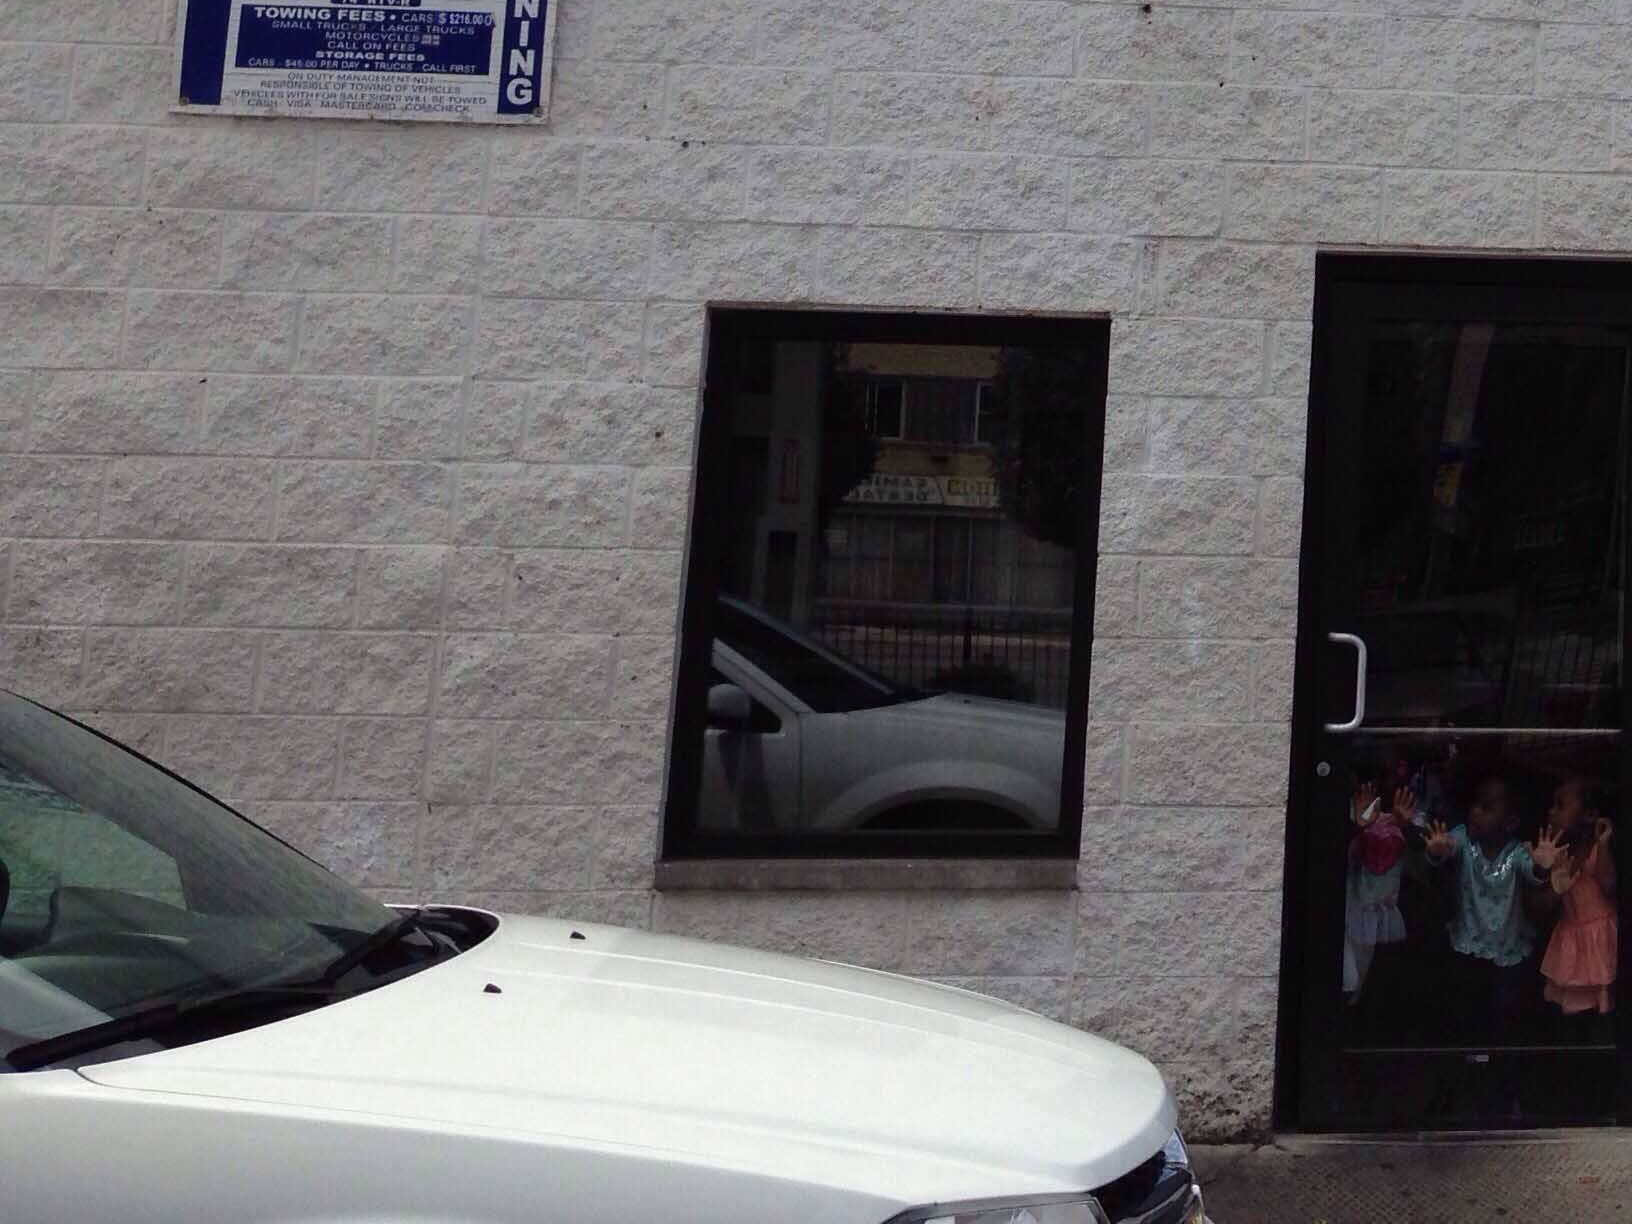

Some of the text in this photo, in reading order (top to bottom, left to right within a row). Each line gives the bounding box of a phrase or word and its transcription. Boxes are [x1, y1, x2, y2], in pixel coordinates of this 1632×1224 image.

[254, 6, 330, 20] TOWING
[338, 9, 385, 22] FEES
[401, 13, 434, 24] CARS
[272, 21, 312, 29] SMALL
[426, 25, 475, 35] TRUCKS
[328, 41, 416, 52] CALL ON FEES
[315, 51, 425, 63] STORAGE FEES
[248, 58, 275, 66] CARS
[341, 61, 360, 69] DAY
[422, 64, 447, 73] CALL
